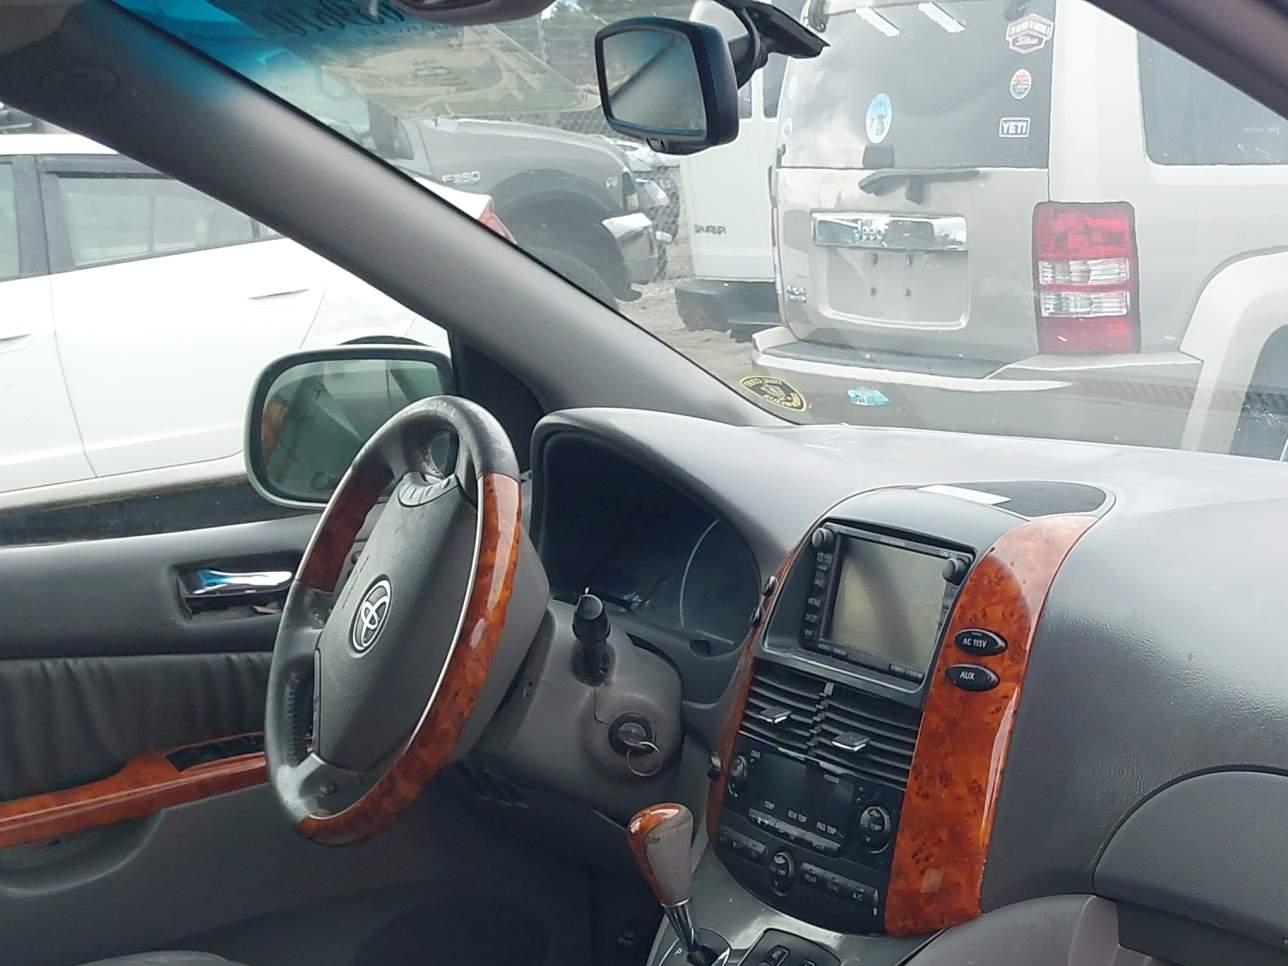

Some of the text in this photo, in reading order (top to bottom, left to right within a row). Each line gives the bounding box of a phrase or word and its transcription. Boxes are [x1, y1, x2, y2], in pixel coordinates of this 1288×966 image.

[1002, 121, 1028, 134] YETI
[962, 637, 988, 649] AC 115V
[959, 671, 976, 681] AUX
